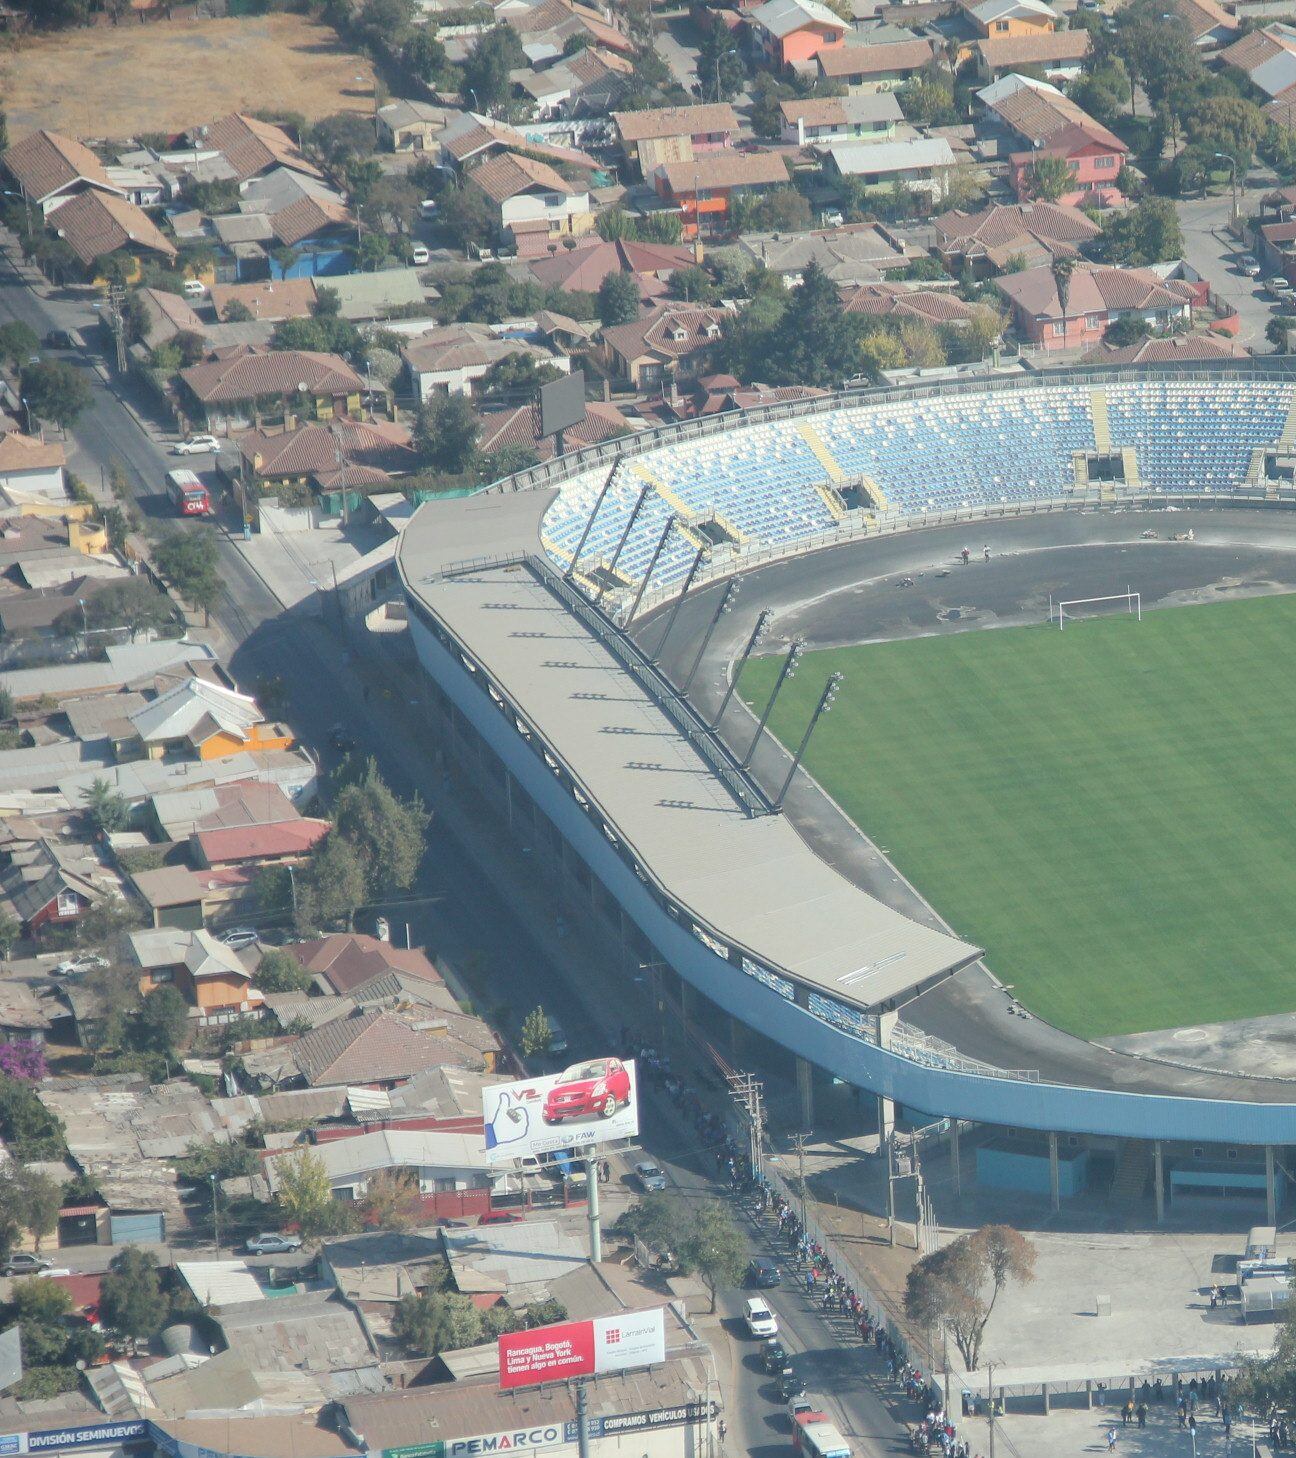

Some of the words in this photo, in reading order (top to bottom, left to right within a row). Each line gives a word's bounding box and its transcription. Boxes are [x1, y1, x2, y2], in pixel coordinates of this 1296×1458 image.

[575, 1131, 596, 1141] FAW
[506, 1346, 544, 1357] Rancagua,
[545, 1340, 573, 1351] Bogotá,
[507, 1356, 525, 1365] Lima
[532, 1352, 555, 1361] Nueva
[556, 1348, 572, 1357] York
[507, 1364, 530, 1374] tienen
[531, 1360, 547, 1370] algo
[548, 1359, 557, 1367] en
[558, 1354, 584, 1365] común.
[604, 1413, 647, 1430] COMPRAMOS
[649, 1408, 687, 1423] VEHÍCULOS
[29, 1430, 75, 1447] DIVISIÓN
[76, 1424, 145, 1442] SEMINUEVOS
[451, 1428, 558, 1456] PEMARCO
